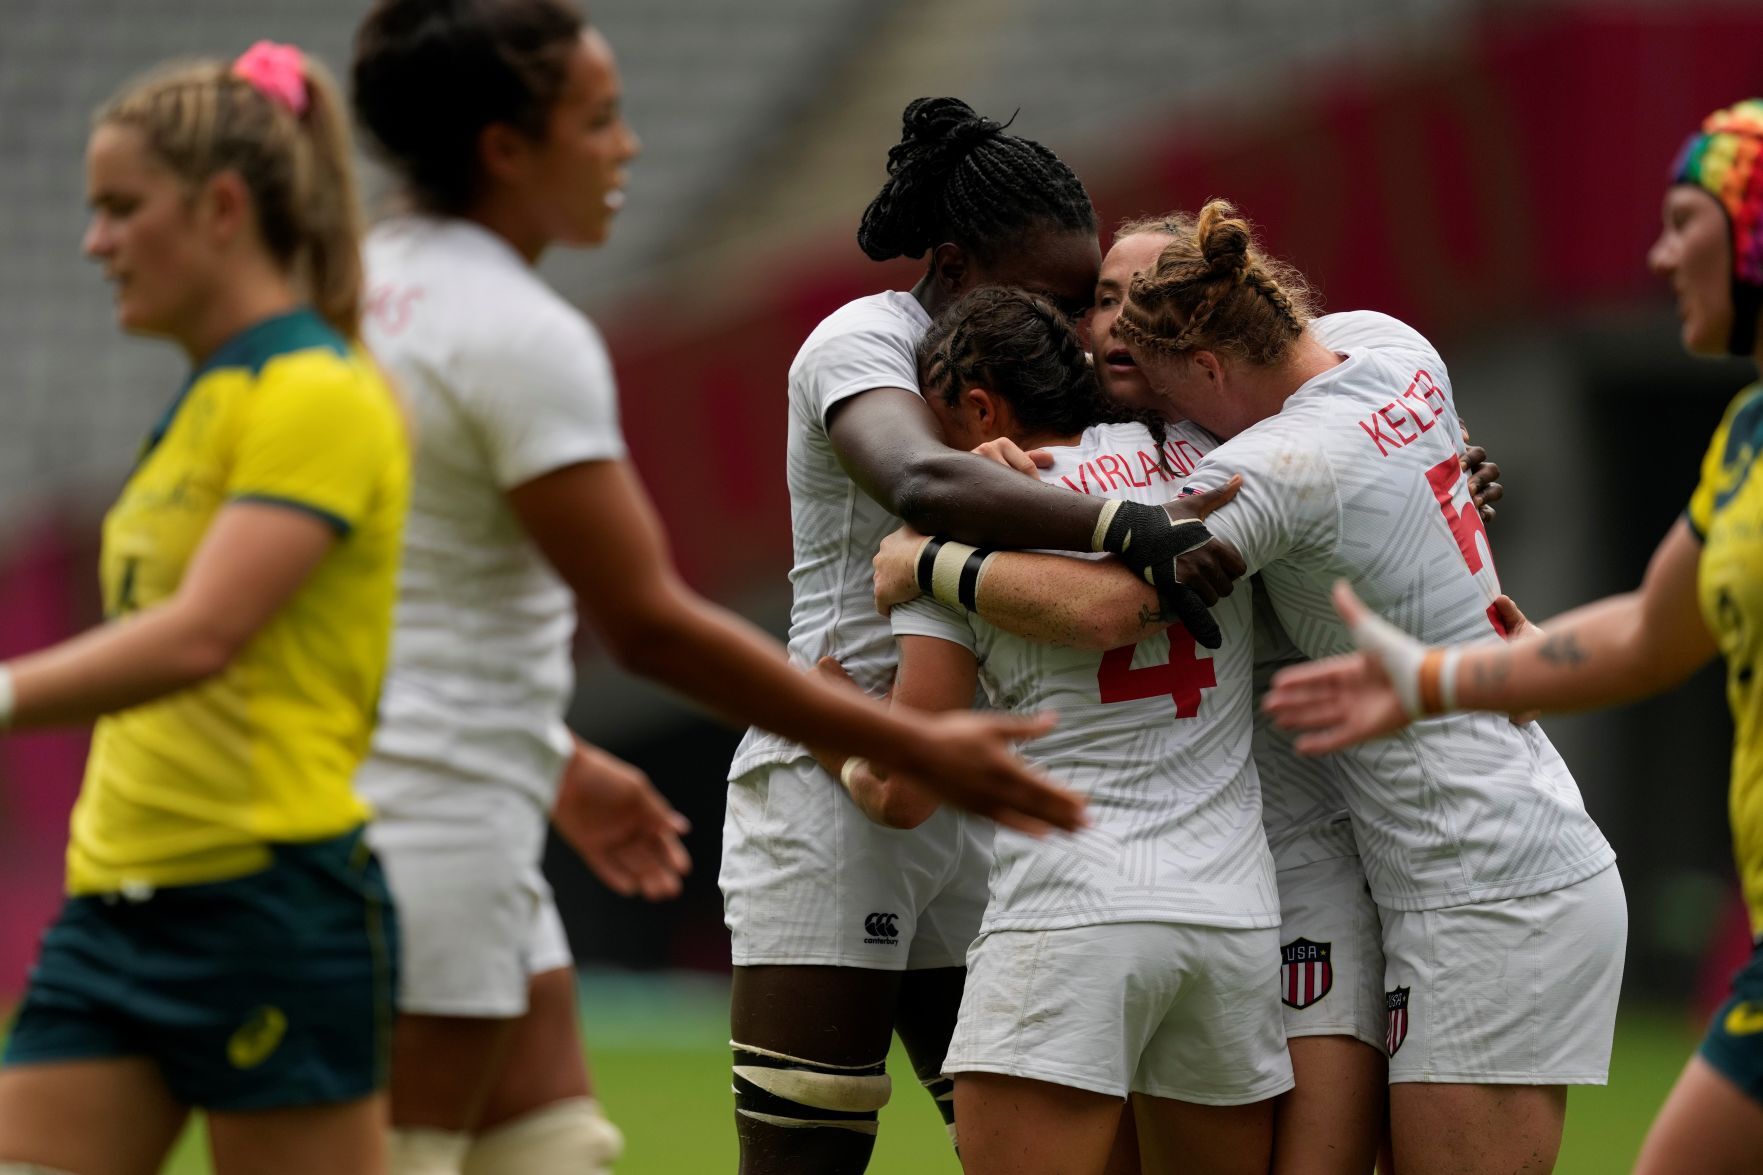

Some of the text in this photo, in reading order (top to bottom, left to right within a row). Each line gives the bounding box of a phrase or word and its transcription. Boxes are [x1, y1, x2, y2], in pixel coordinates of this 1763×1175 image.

[1097, 622, 1217, 719] 4
[864, 937, 898, 947] canterbury
[1287, 945, 1317, 961] USA
[1388, 993, 1402, 1008] USA
